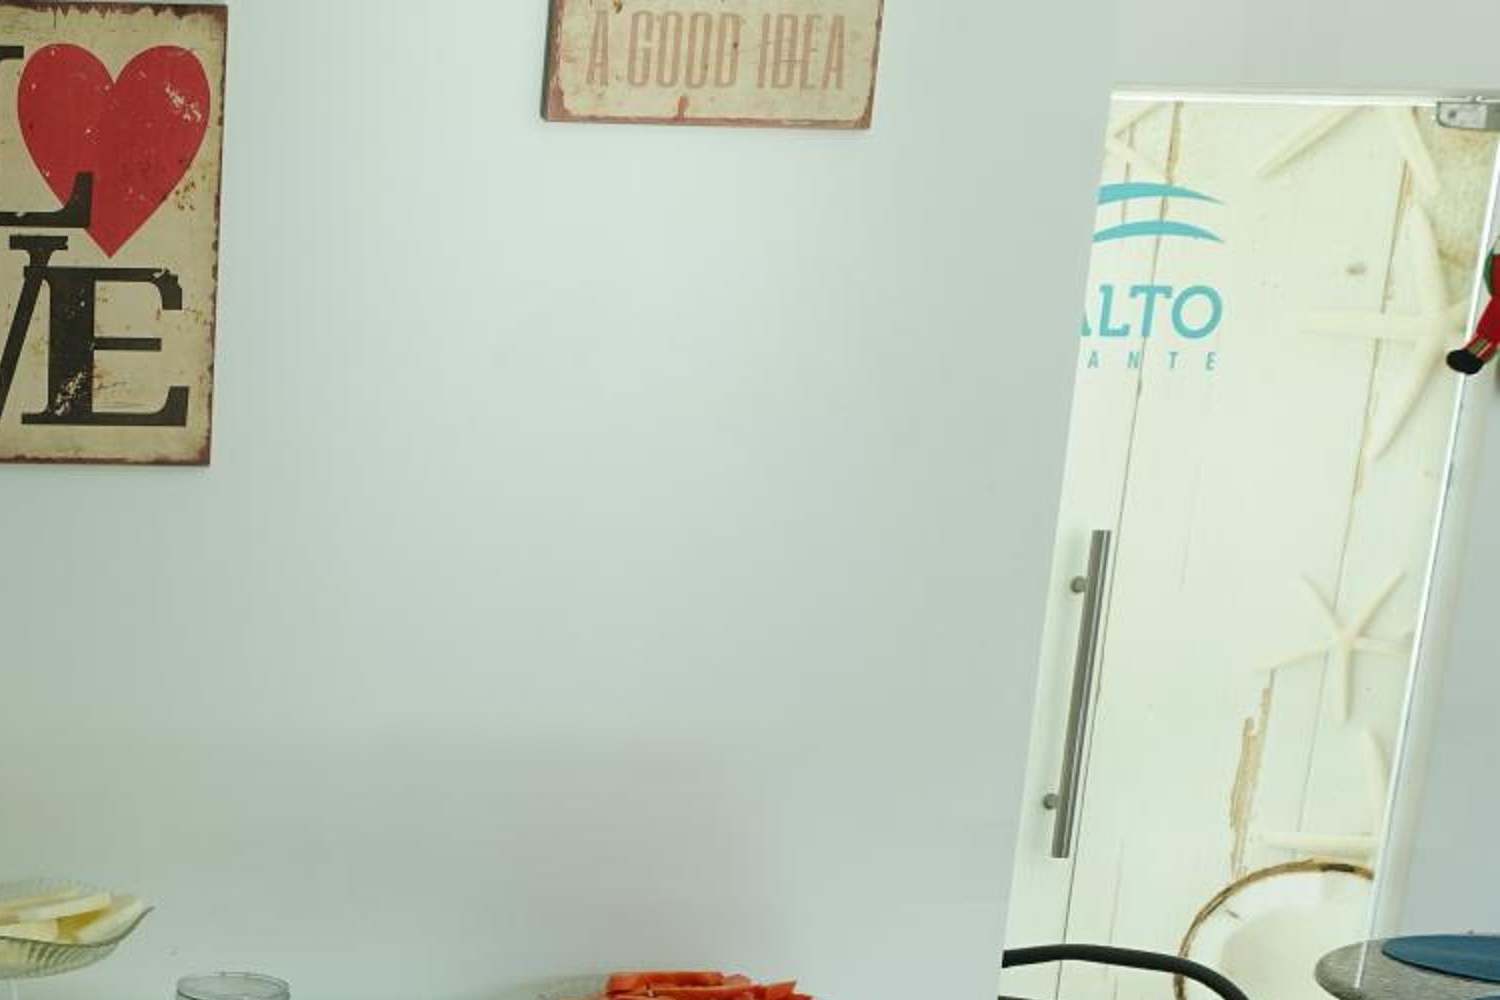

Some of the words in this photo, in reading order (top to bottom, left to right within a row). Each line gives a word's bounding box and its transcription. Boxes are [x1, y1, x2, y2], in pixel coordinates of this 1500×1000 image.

[586, 9, 610, 88] A
[626, 9, 742, 89] GOOD
[756, 13, 846, 90] IDEA
